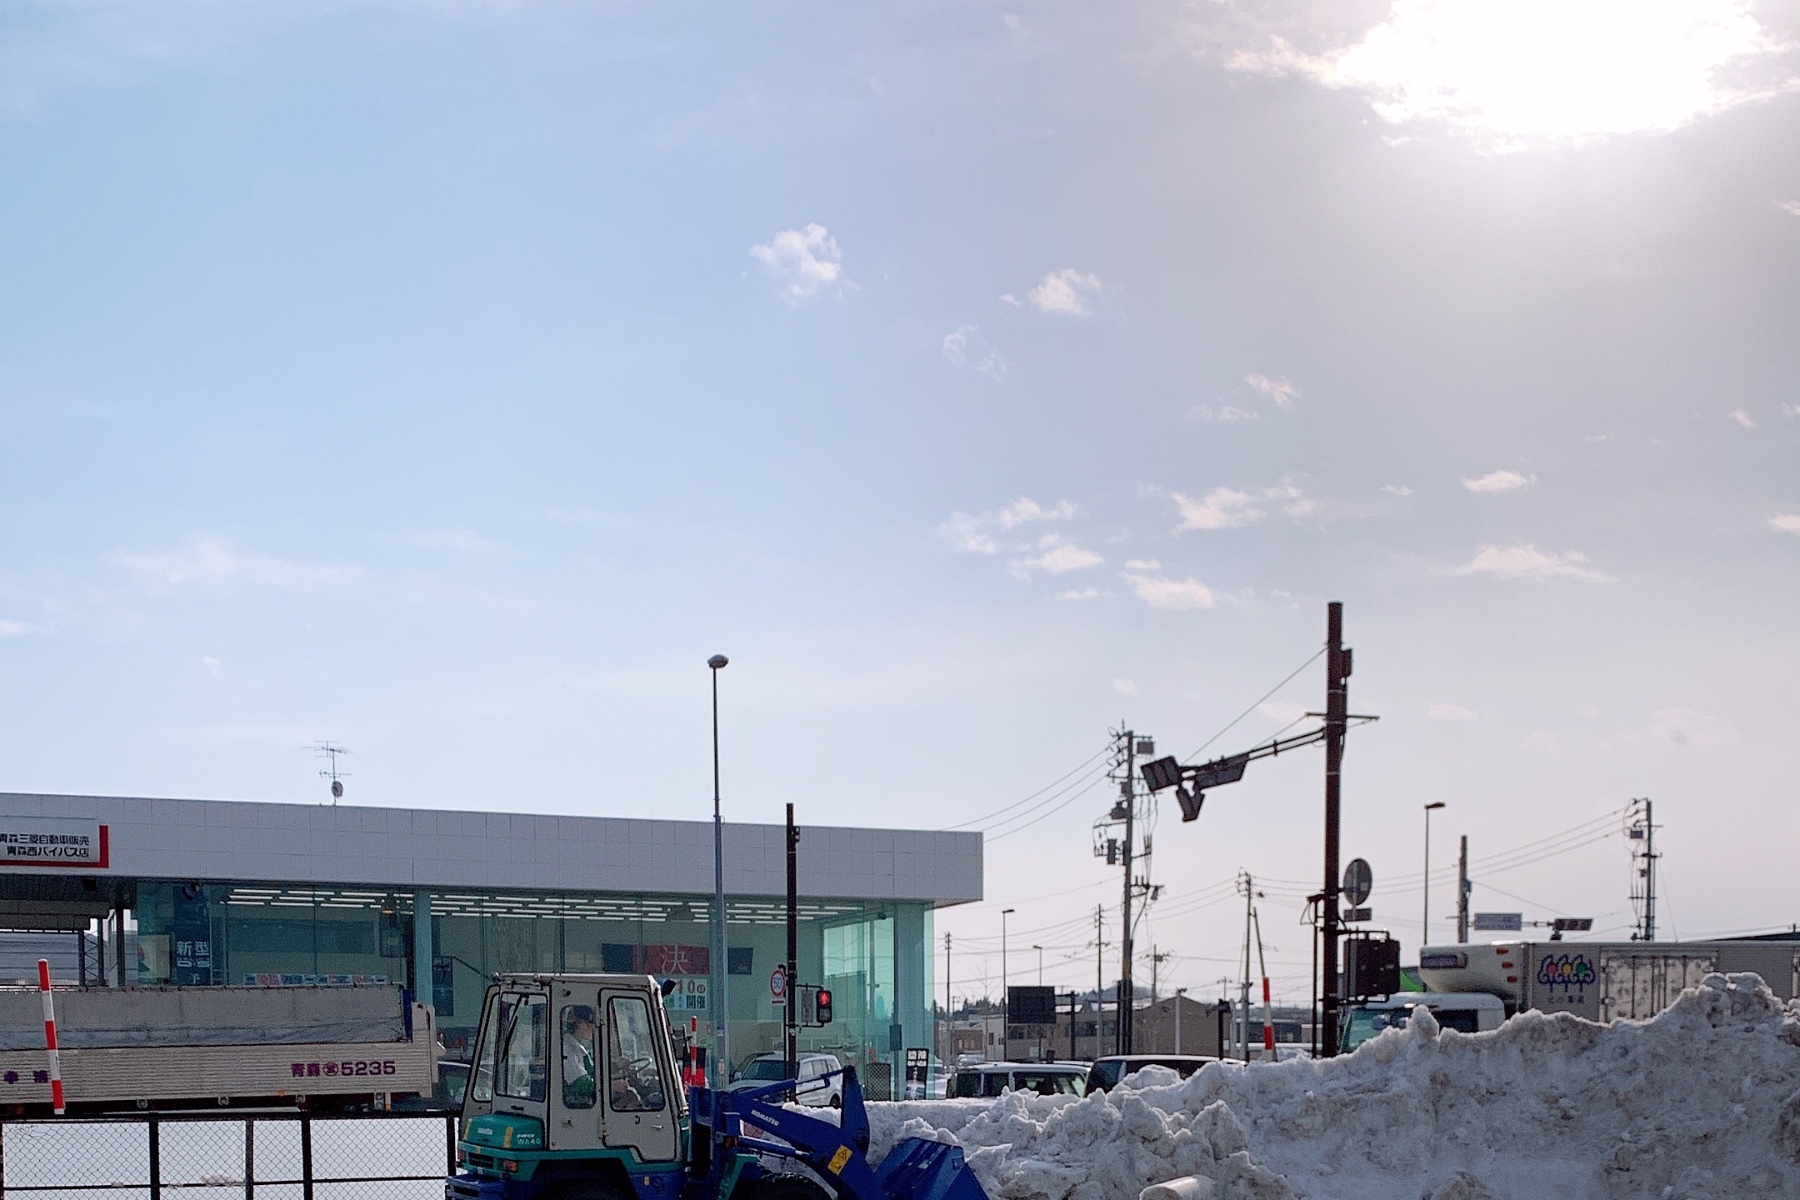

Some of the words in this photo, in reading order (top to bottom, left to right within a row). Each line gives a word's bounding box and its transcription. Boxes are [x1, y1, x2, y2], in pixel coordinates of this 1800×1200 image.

[7, 846, 89, 858] 青森西バイパス店
[176, 941, 210, 957] 新型
[751, 1109, 780, 1126] KOMATSU
